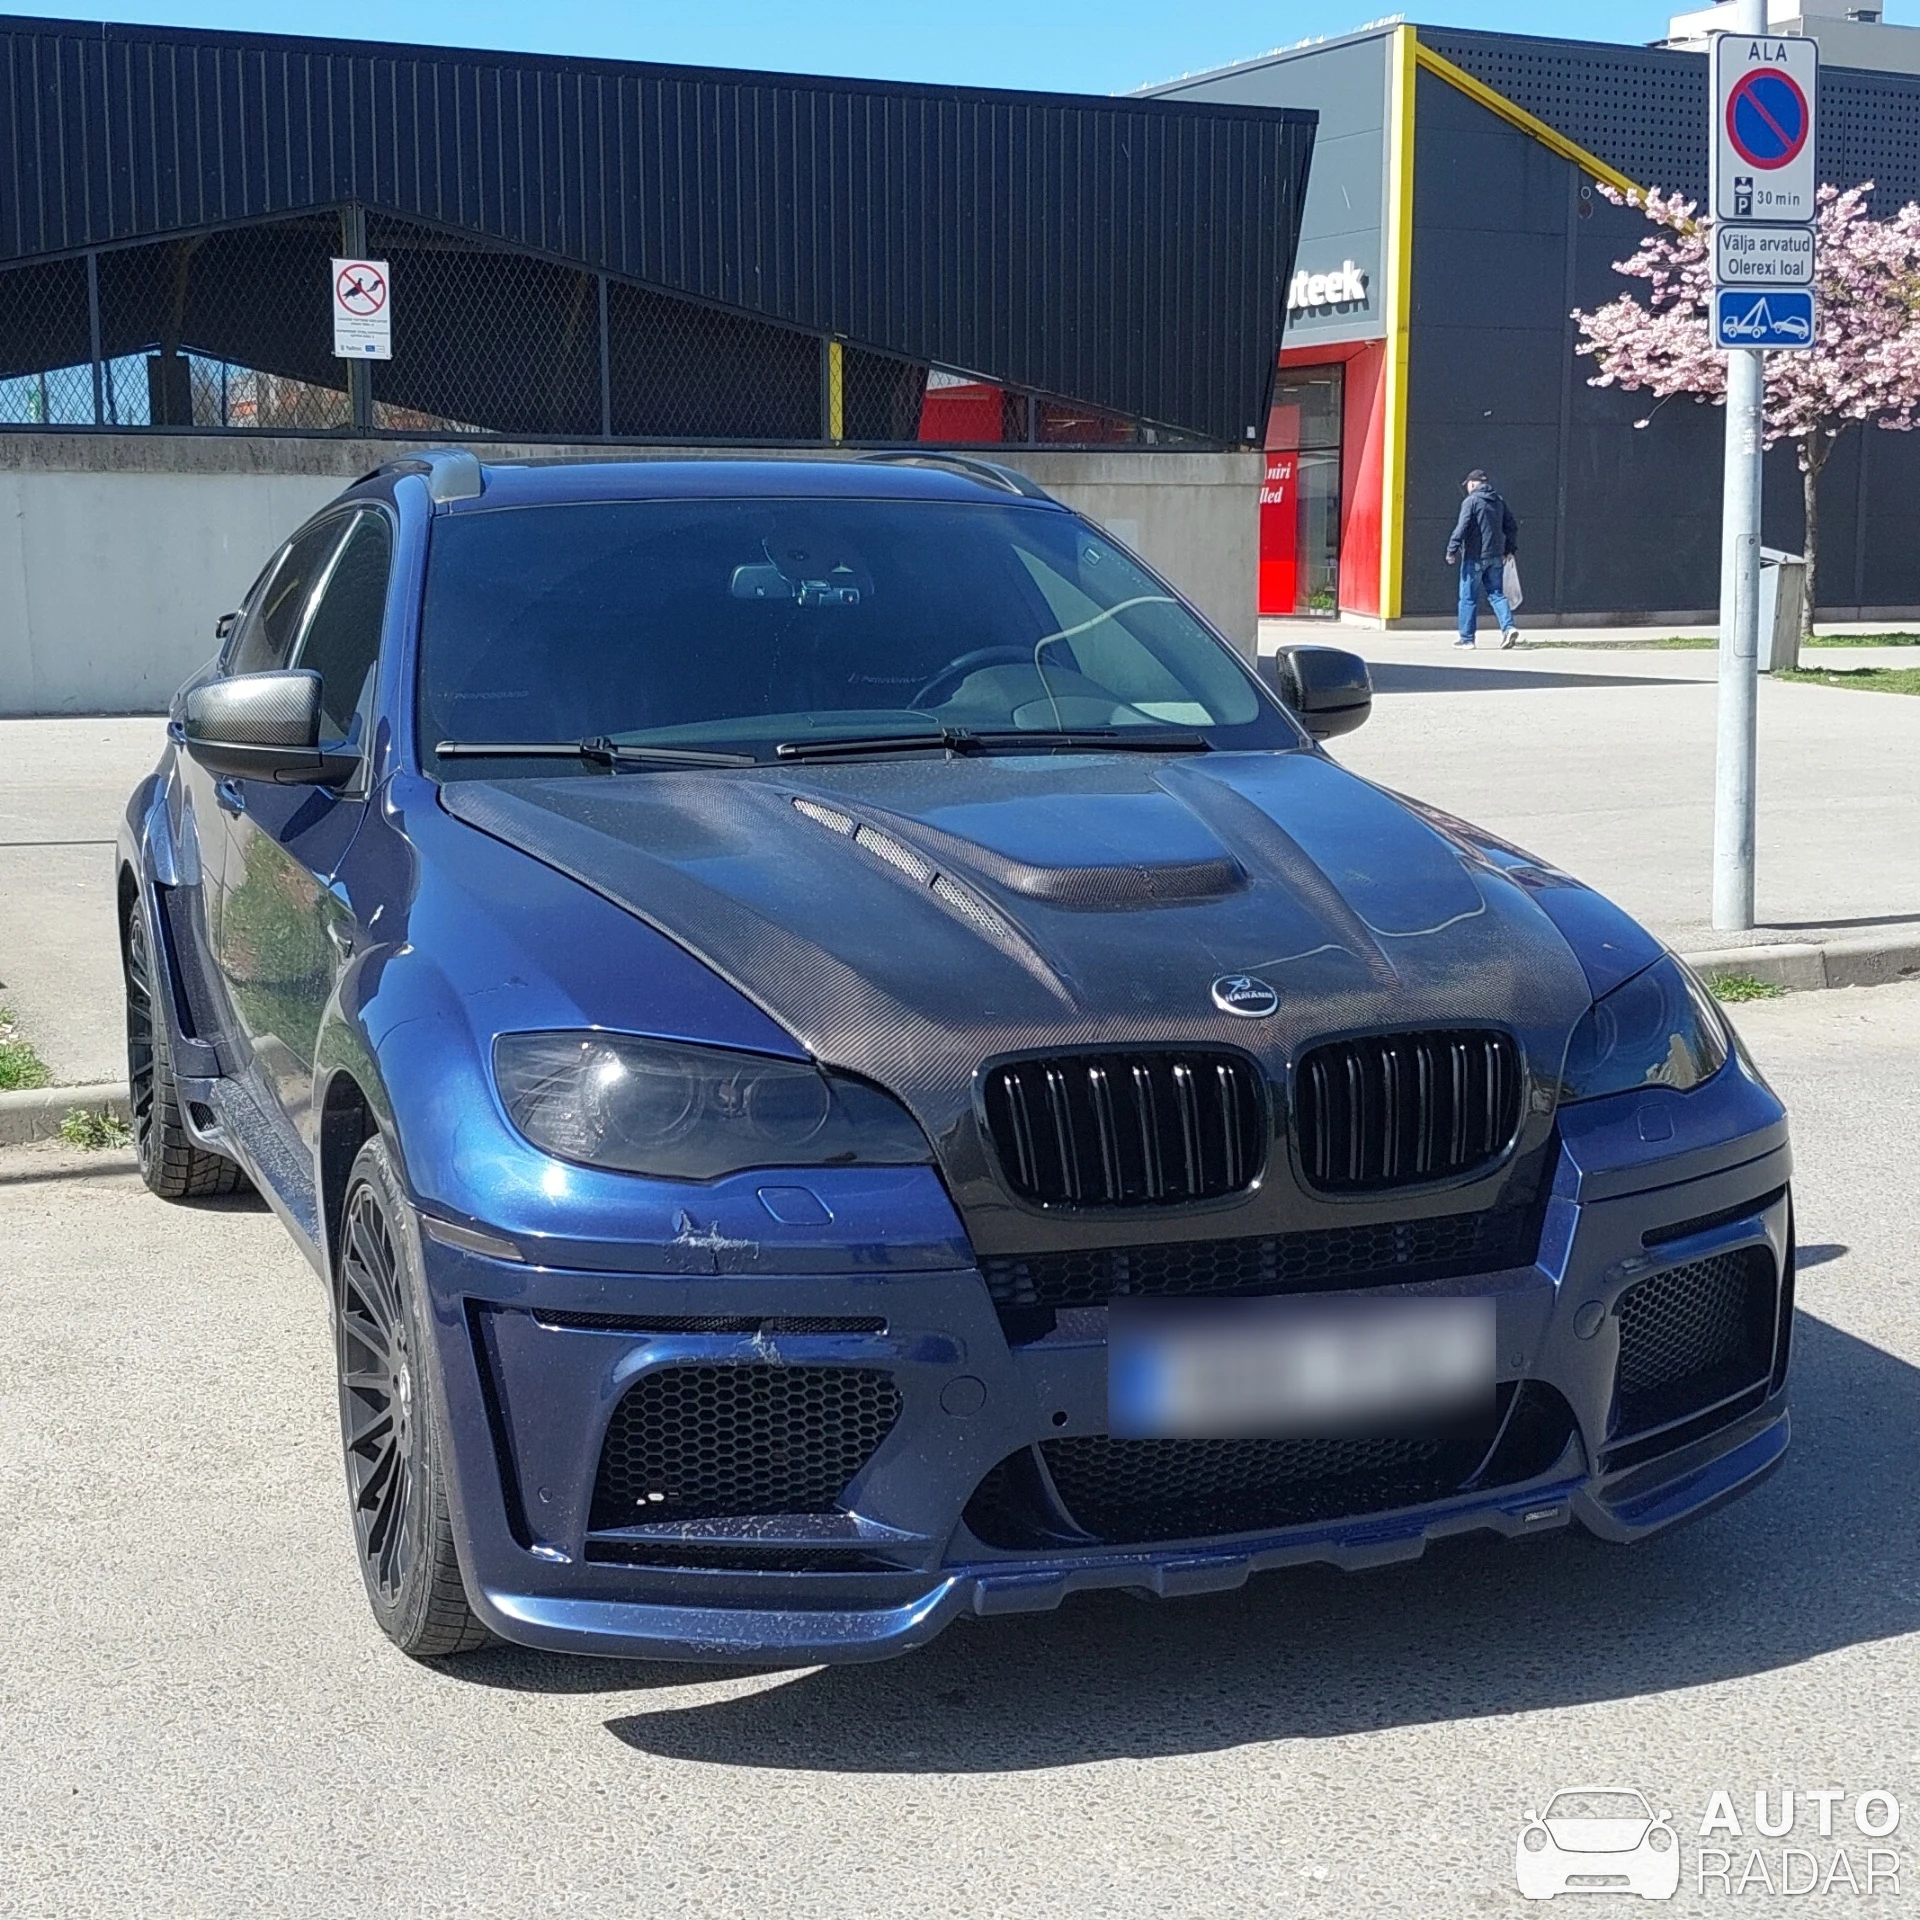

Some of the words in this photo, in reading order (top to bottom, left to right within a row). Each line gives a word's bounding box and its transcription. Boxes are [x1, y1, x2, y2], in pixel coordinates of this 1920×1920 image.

[1747, 41, 1789, 62] ALA
[1757, 190, 1773, 205] 30
[1775, 192, 1801, 206] min
[1722, 234, 1756, 255] Välja
[1759, 236, 1811, 253] arvatud
[1728, 258, 1776, 276] Olerexi
[1780, 259, 1804, 276] loal
